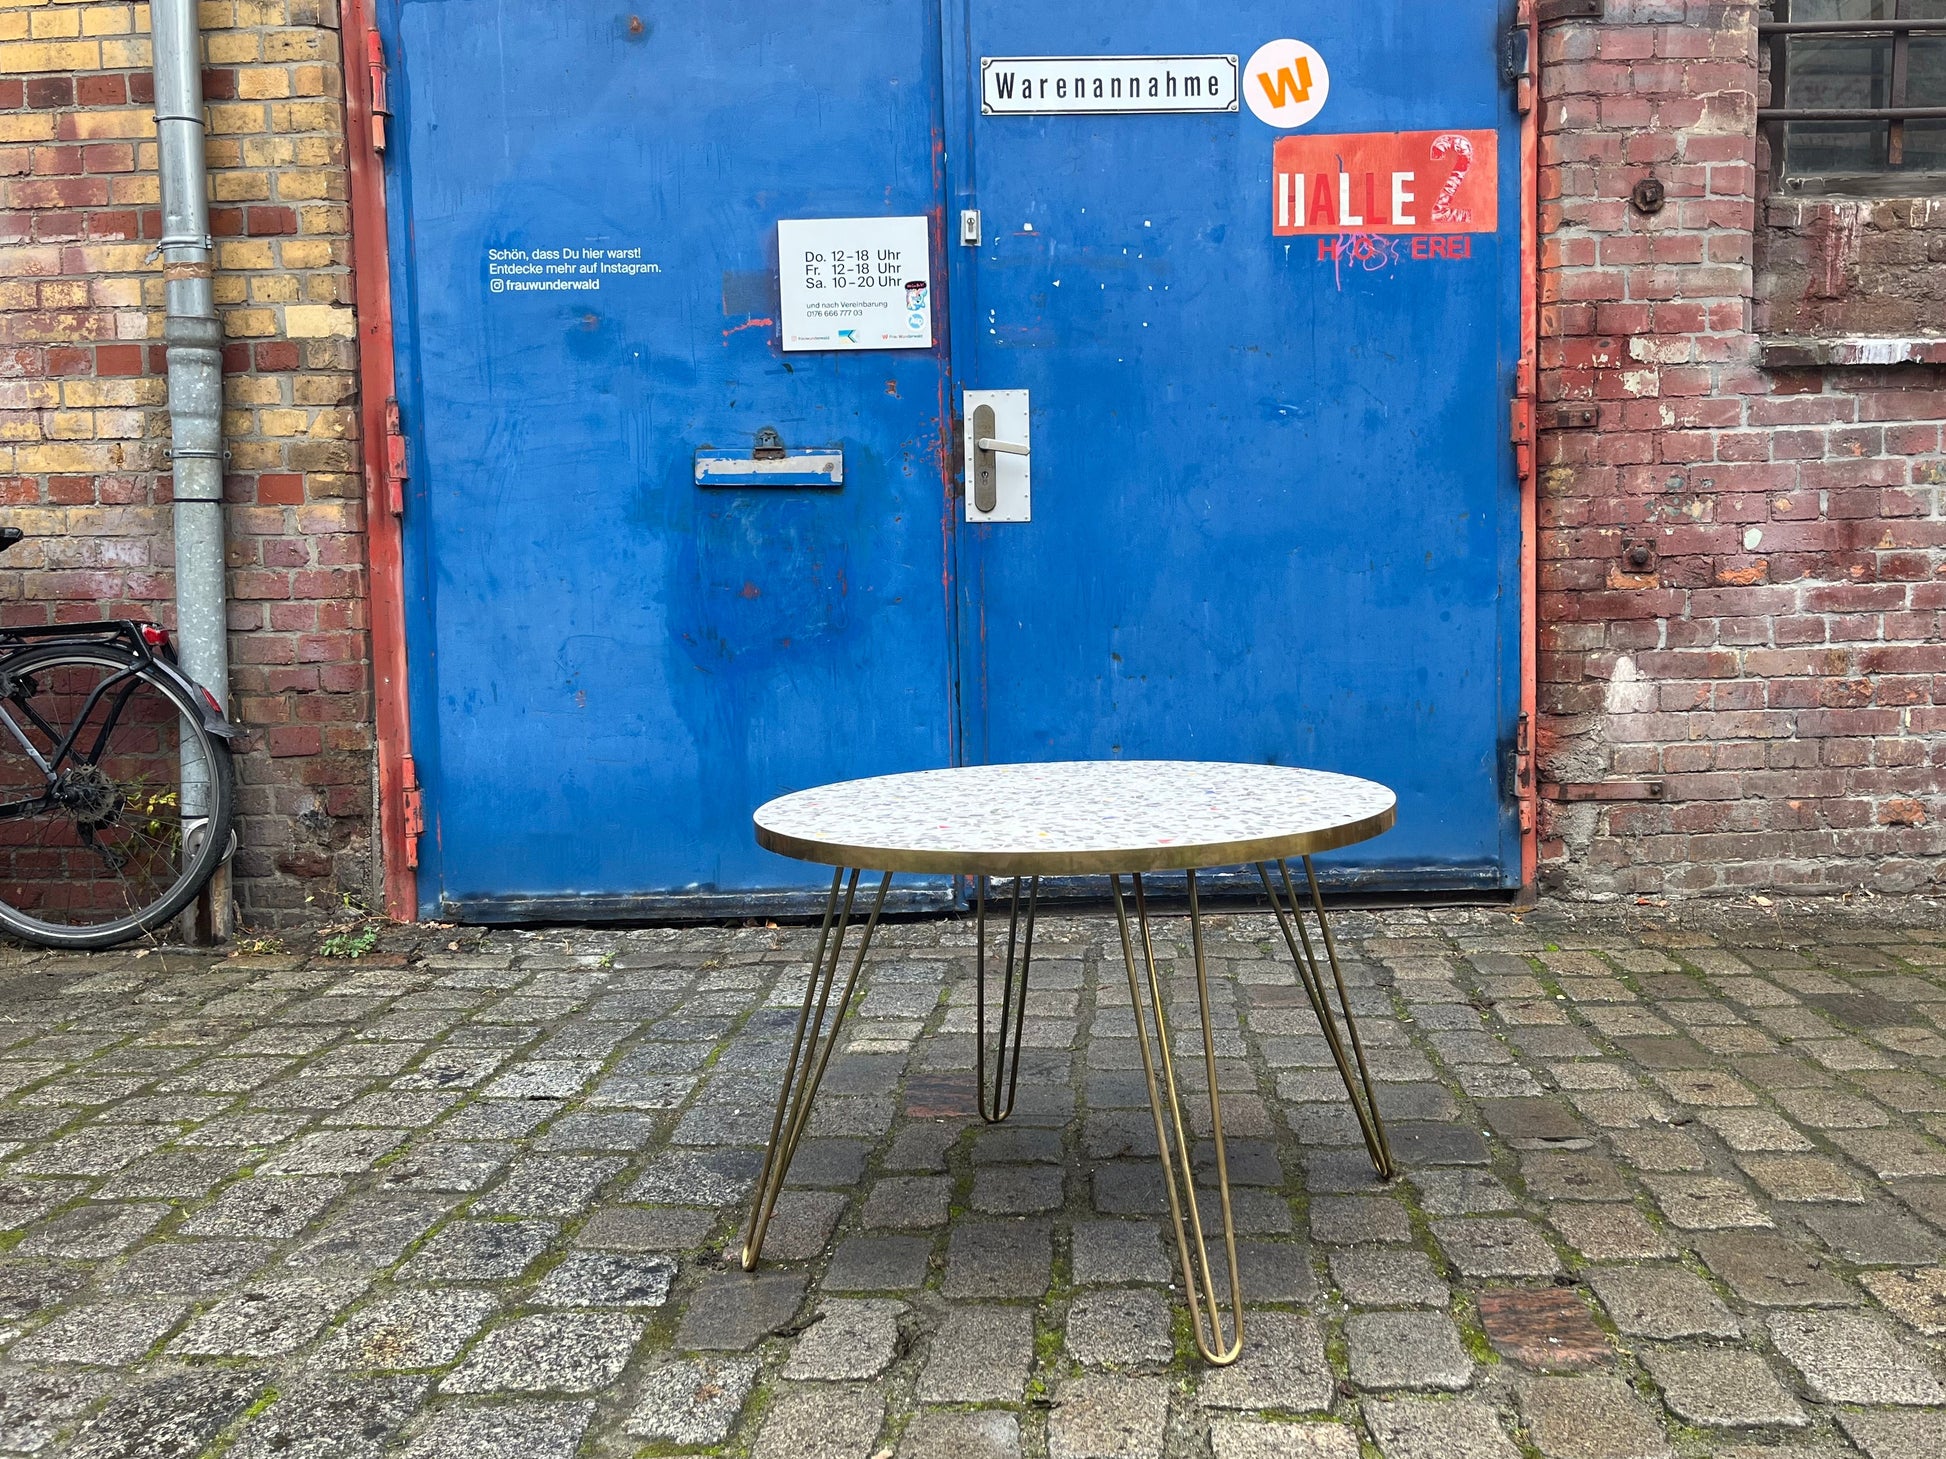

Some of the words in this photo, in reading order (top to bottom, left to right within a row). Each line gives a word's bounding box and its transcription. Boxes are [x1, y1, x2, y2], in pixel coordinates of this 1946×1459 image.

[996, 71, 1218, 99] Warenannahme
[1278, 171, 1416, 227] HALLE
[1430, 134, 1473, 224] 2
[488, 248, 529, 262] Schön,
[531, 248, 560, 260] dass
[562, 247, 580, 260] Du
[582, 247, 605, 259] hier
[606, 247, 641, 259] warst!
[805, 251, 827, 263] Do.
[877, 249, 901, 261] Uhr
[489, 262, 544, 275] Entdecke
[545, 262, 577, 274] mehr
[579, 262, 598, 274] auf
[600, 262, 662, 276] Instagram.
[805, 264, 821, 276] Fr.
[877, 262, 902, 274] Uhr
[505, 278, 600, 291] frauwunderwald
[805, 277, 827, 289] Sa.
[878, 275, 902, 288] Uhr
[821, 301, 840, 309] nach
[840, 300, 888, 309] Vereinbarung
[806, 310, 823, 318] 0176
[823, 309, 839, 318] 666
[839, 309, 852, 317] 777
[852, 309, 863, 317] 03
